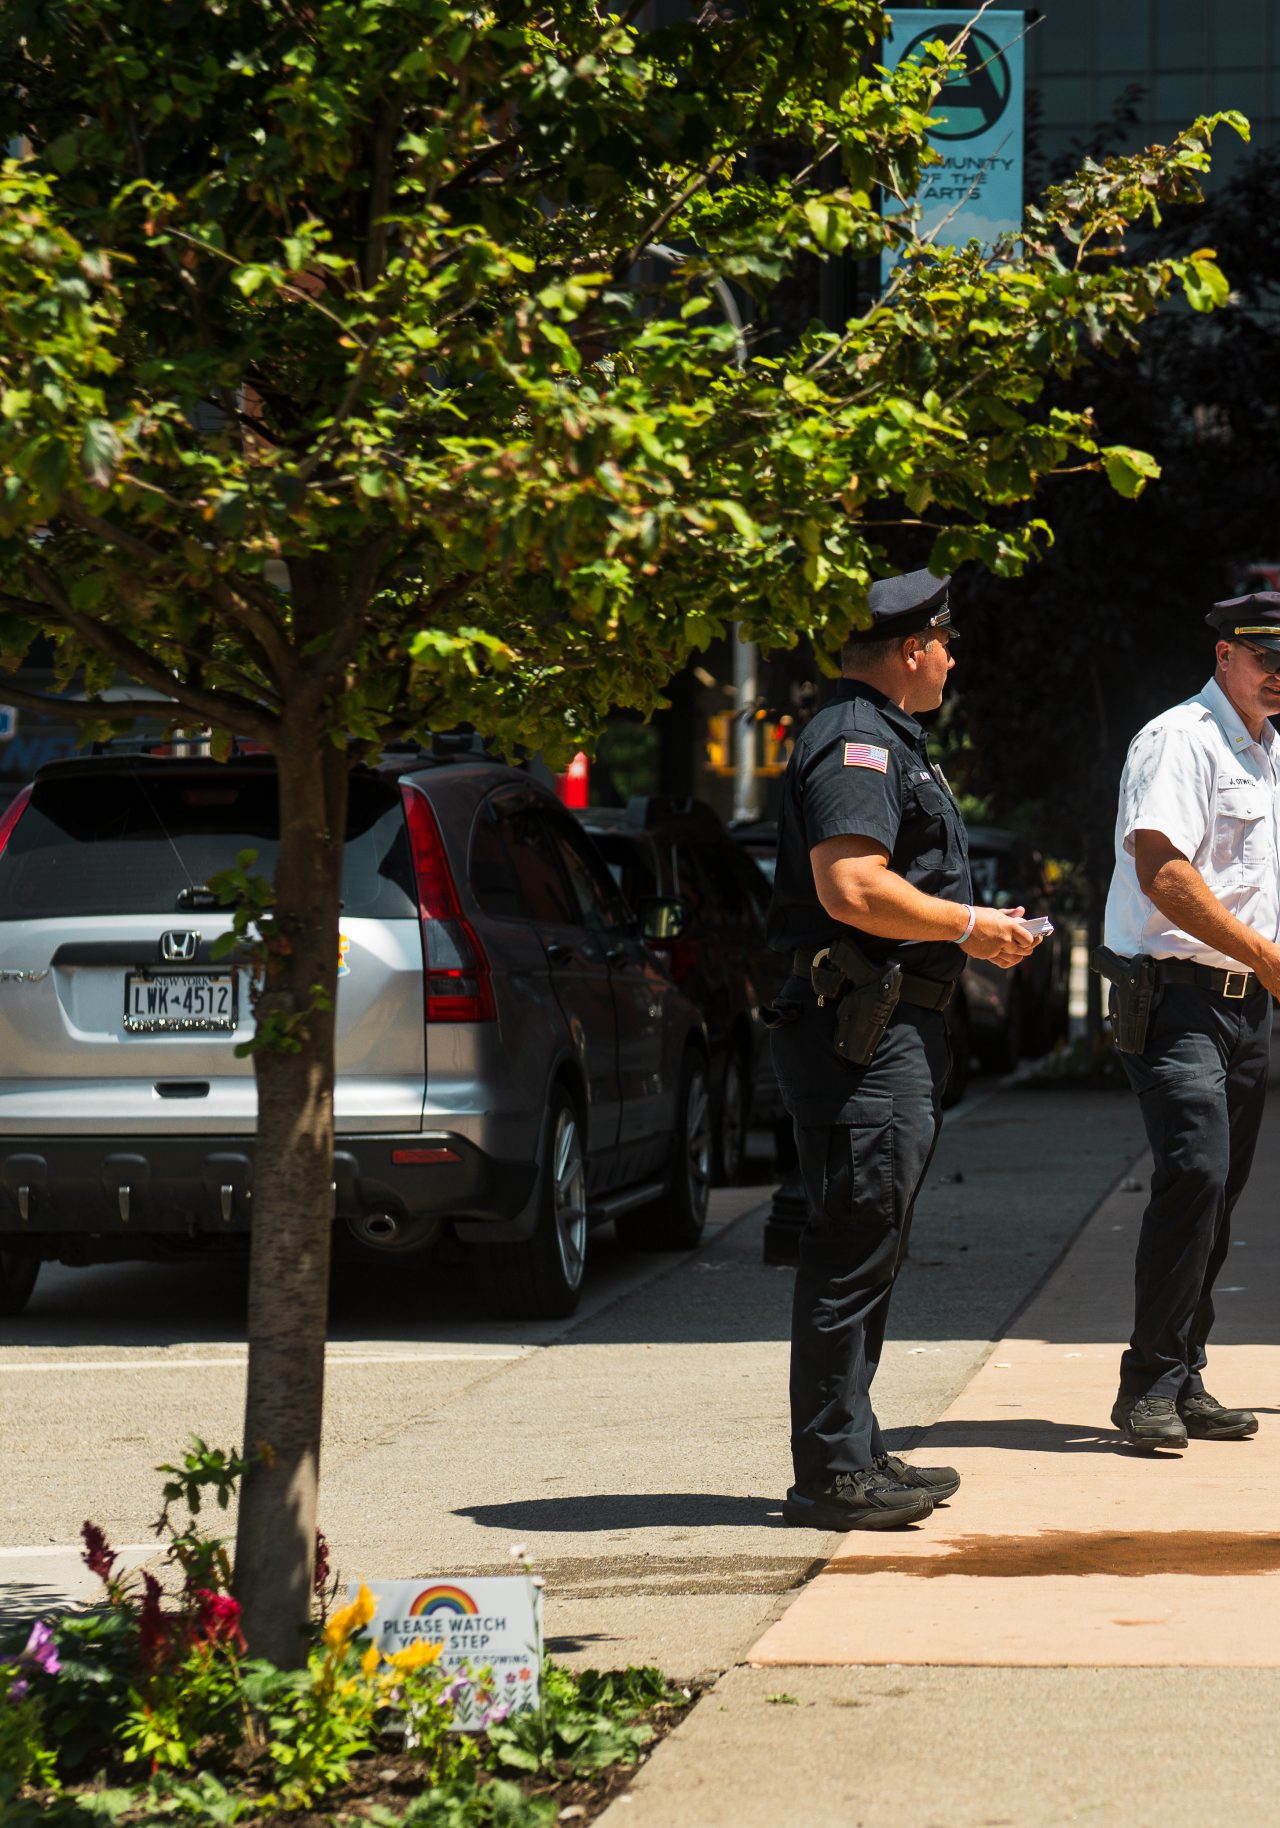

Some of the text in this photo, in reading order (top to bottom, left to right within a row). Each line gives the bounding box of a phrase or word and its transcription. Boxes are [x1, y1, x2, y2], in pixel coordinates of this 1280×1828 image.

[918, 156, 1014, 171] MUNITY
[919, 172, 987, 184] OF THE
[924, 187, 981, 200] ARTS
[154, 976, 209, 986] NEW YORK
[134, 986, 229, 1015] LWK 4512
[383, 1617, 507, 1634] PLEASE WATCH
[451, 1635, 491, 1649] STEP
[448, 1655, 469, 1666] AR
